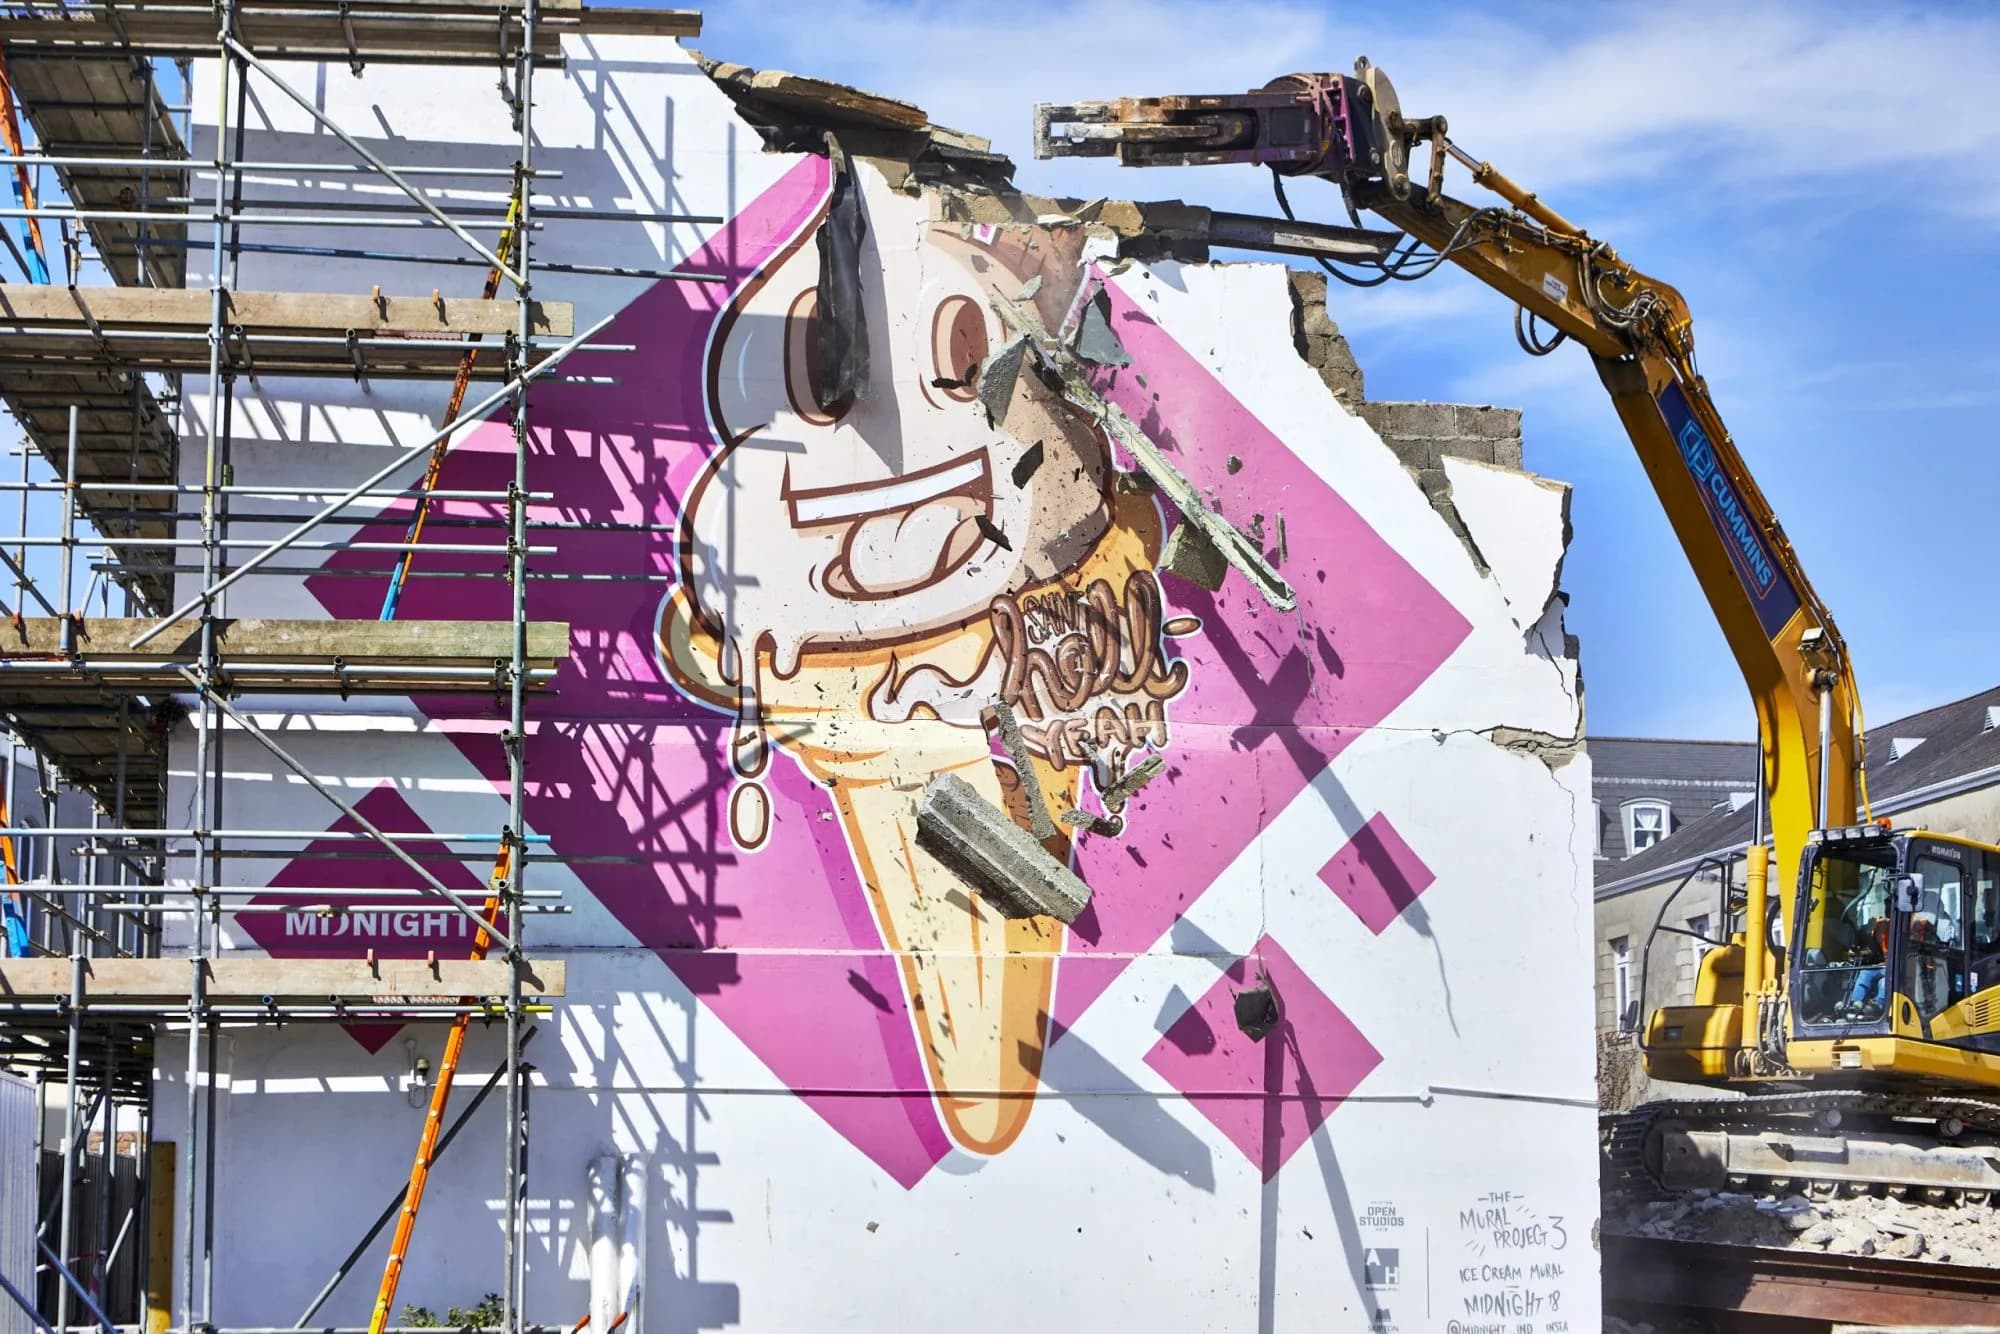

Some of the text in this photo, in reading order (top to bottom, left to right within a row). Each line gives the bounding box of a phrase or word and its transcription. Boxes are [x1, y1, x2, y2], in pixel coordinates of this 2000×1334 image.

[1711, 474, 1771, 585] CUMMINS
[1931, 846, 1961, 859] KOMATSU
[1359, 1216, 1405, 1227] STUDIOS
[1367, 1207, 1396, 1216] OPEN
[1460, 1206, 1511, 1232] MURAL
[1494, 1215, 1567, 1250] PROJECT 3
[1460, 1263, 1564, 1283] ICE CREAM MURAL
[1463, 1288, 1544, 1318] MIDNIGHT
